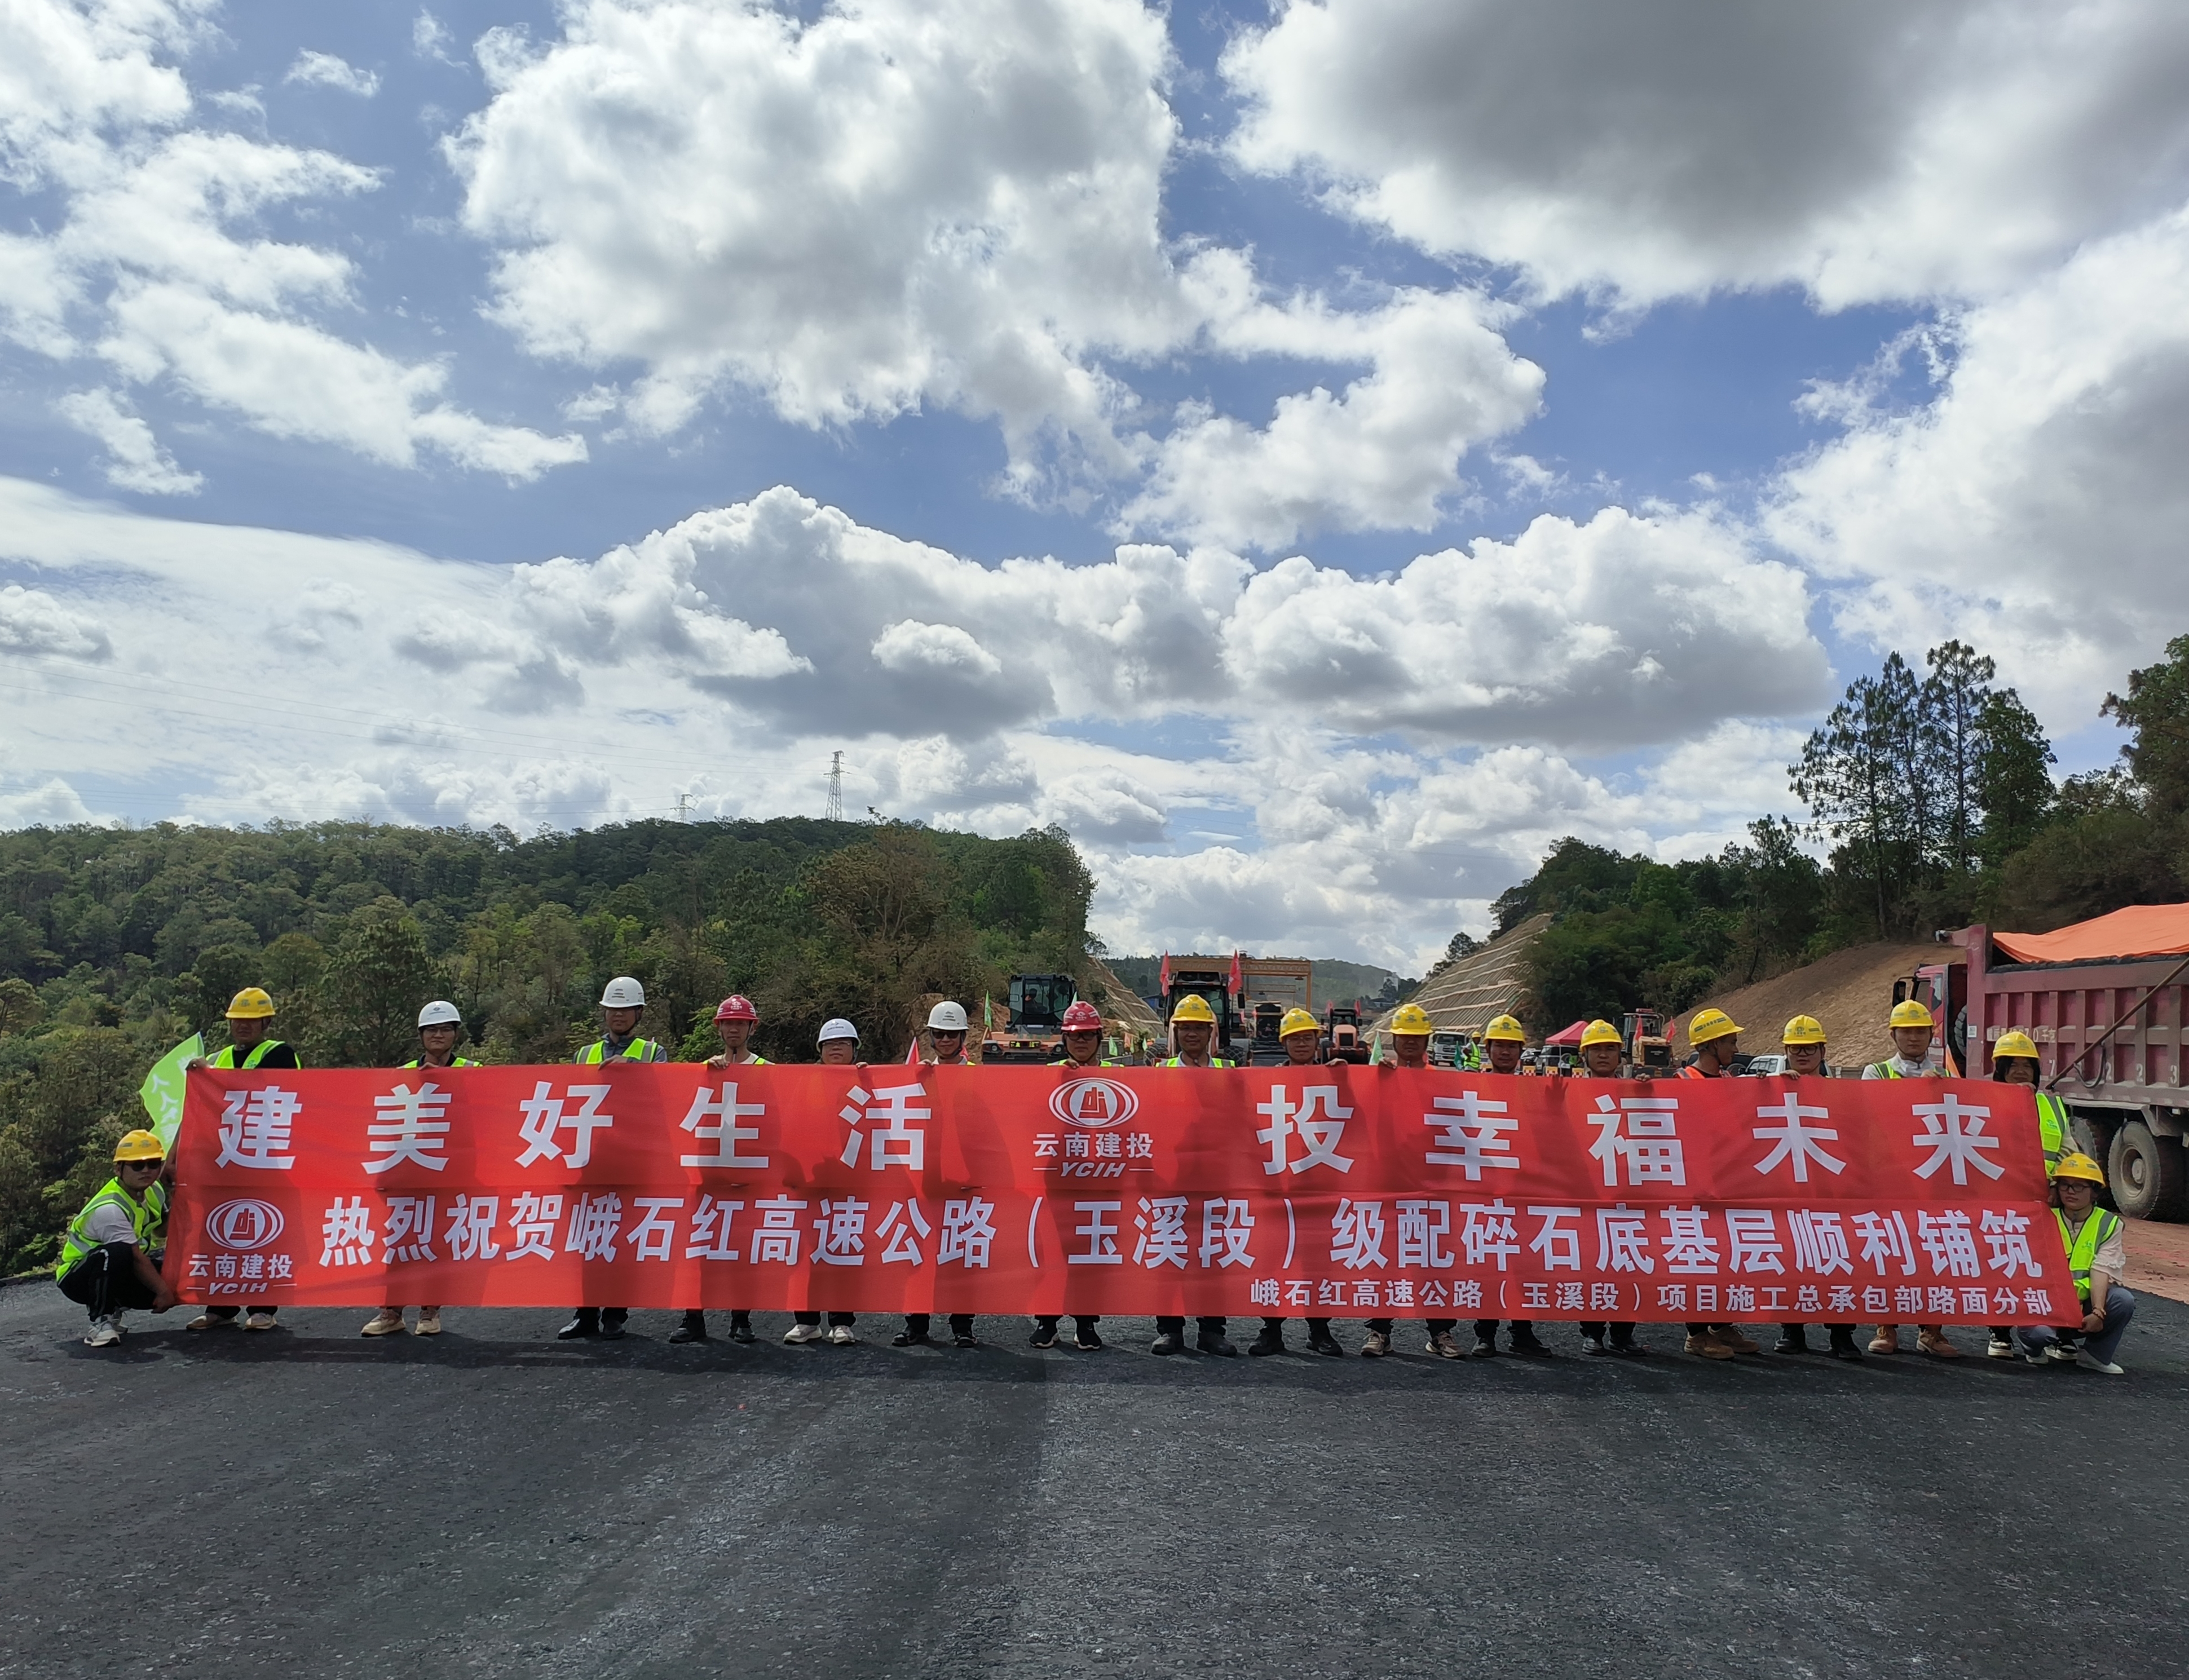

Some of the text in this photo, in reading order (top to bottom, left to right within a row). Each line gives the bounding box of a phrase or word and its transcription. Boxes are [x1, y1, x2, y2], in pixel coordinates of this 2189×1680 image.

[214, 1081, 2006, 1187] 建美好生活 投幸福未来
[1033, 1131, 1154, 1159] 云南建投
[1060, 1162, 1127, 1178] YCIH
[188, 1252, 293, 1280] 云南建投
[208, 1281, 268, 1296] YCIH
